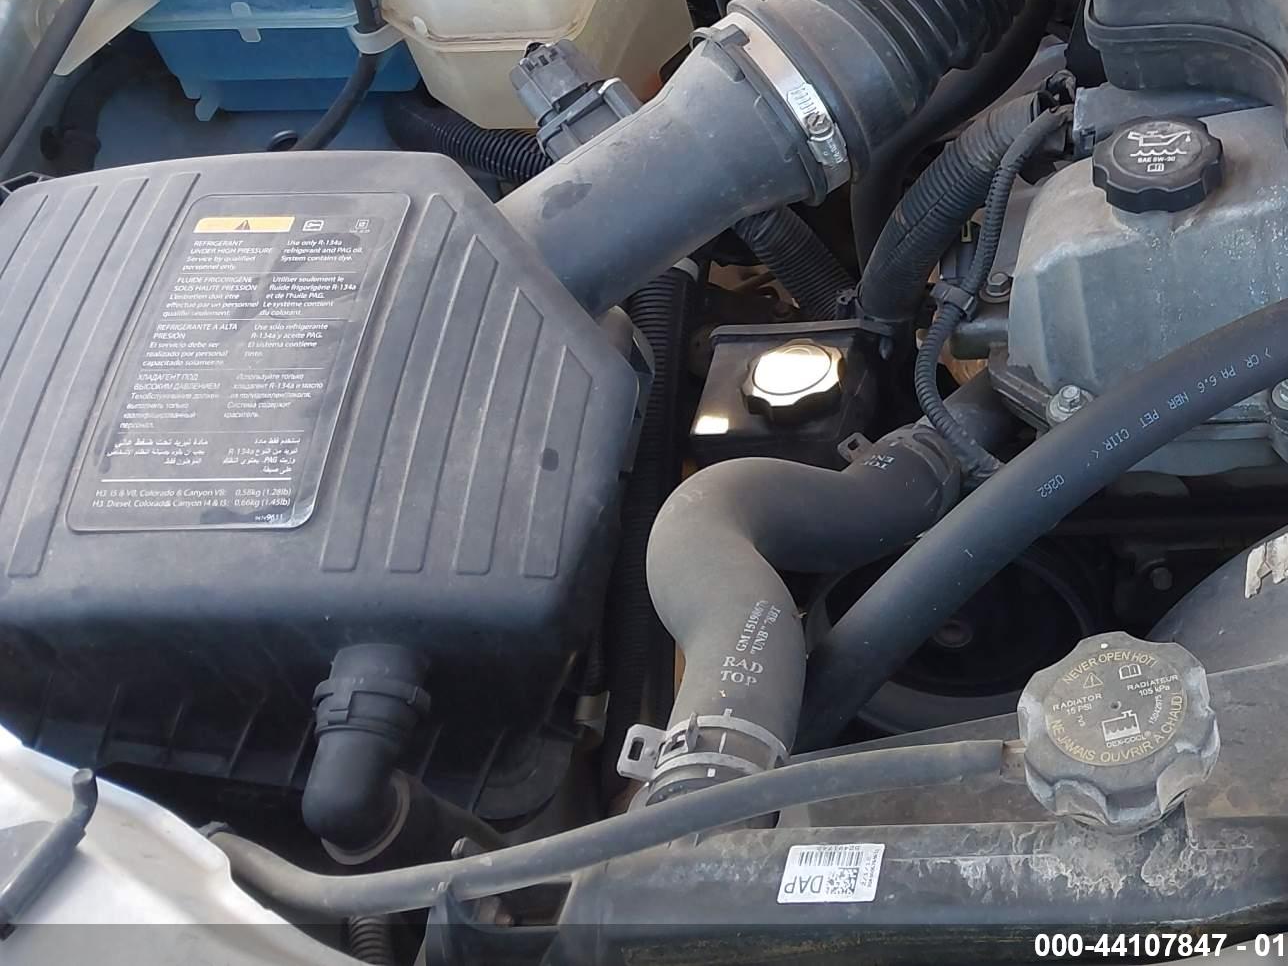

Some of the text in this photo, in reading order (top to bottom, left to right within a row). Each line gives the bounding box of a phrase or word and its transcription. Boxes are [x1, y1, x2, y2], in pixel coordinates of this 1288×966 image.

[287, 239, 343, 248] Use only R-134a
[283, 247, 322, 255] refrigerant
[323, 247, 335, 255] and
[337, 247, 352, 255] PAG
[186, 255, 257, 264] Service by qualified
[280, 255, 306, 263] System
[307, 255, 337, 263] contains
[182, 264, 219, 272] personnel
[177, 276, 202, 284] FLUIDE
[269, 284, 289, 292] fluide
[197, 301, 211, 309] par
[211, 301, 222, 309] un
[222, 301, 259, 309] personnel
[262, 301, 272, 309] Le
[303, 301, 334, 309] contient
[221, 323, 238, 331] ALTA
[254, 323, 267, 331] Use
[285, 323, 329, 331] refrigerante
[251, 332, 275, 340] R-134a
[283, 332, 305, 340] aceite
[150, 341, 157, 349] El
[187, 341, 208, 349] debe
[208, 341, 220, 349] ser
[146, 350, 229, 358] realizado por personal
[142, 359, 183, 367] capacitado
[1246, 354, 1260, 369] CR
[1220, 364, 1237, 380] PA
[1167, 392, 1190, 411] NBR
[1139, 409, 1160, 428] PET
[139, 489, 175, 497] Colorado
[183, 489, 213, 497] Canyon
[172, 499, 202, 507] Canyon
[735, 634, 751, 652] GM
[722, 656, 764, 674] RAD
[1062, 651, 1157, 685] NEVER OPEN HOT!
[720, 670, 757, 687] TOP
[1126, 674, 1179, 691] RADIATEUR
[1138, 684, 1171, 698] 105 kPa
[1052, 693, 1102, 712] RADIATOR
[1077, 703, 1093, 714] PSI
[1051, 719, 1065, 735] NE
[1057, 735, 1096, 761] JAMAIS
[1100, 741, 1155, 763] OUVRIR
[784, 875, 824, 894] DAP
